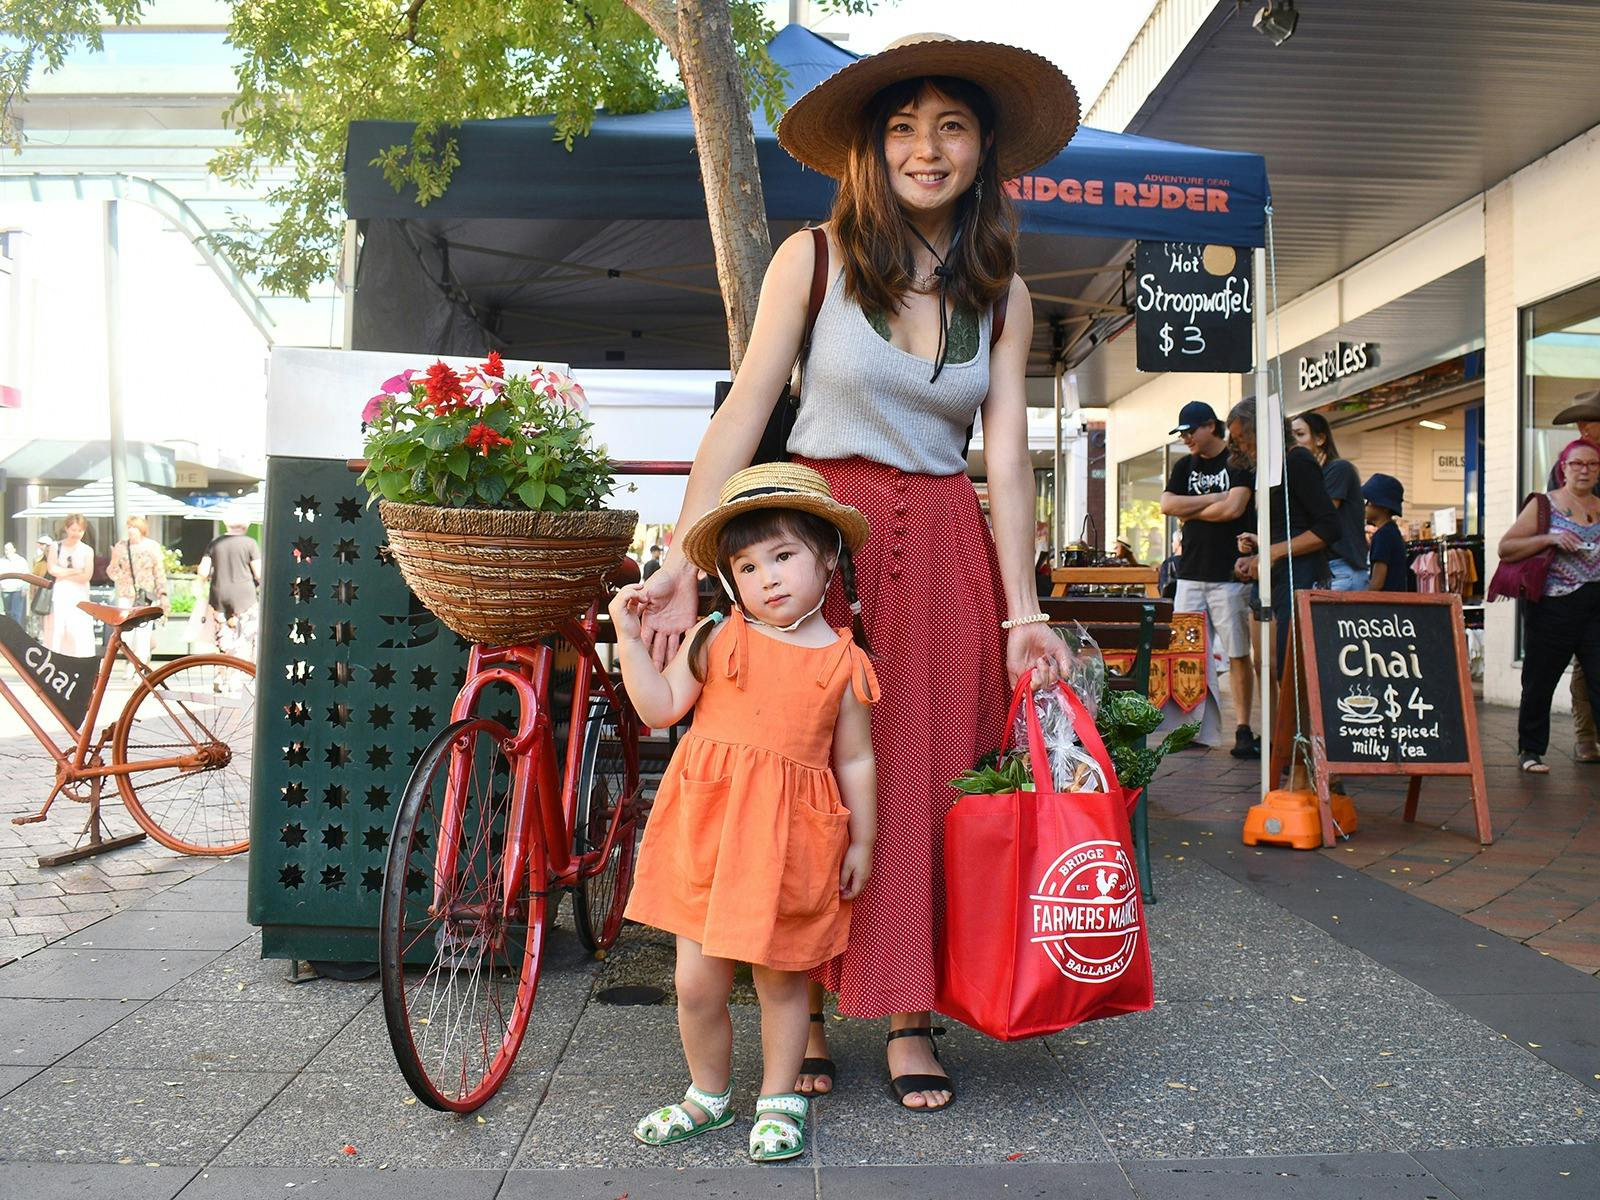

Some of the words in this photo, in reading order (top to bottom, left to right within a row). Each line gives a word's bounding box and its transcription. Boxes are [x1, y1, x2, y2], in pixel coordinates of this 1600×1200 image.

[1144, 173, 1204, 186] ADVENTURE
[1206, 178, 1230, 187] GEAR
[1114, 181, 1230, 214] RYDER
[1169, 252, 1200, 273] Hot
[1137, 274, 1252, 324] Stroopwafel
[1337, 614, 1417, 639] masala
[1338, 639, 1423, 679] Chai
[1339, 724, 1386, 739] sweet
[1391, 722, 1440, 743] spiced
[1352, 738, 1390, 761] milky
[1400, 741, 1427, 758] tea
[1058, 848, 1104, 877] BRIDGE
[1076, 884, 1090, 892] EST
[1033, 904, 1105, 933] FARMERS
[1065, 956, 1126, 977] BALLARAT
